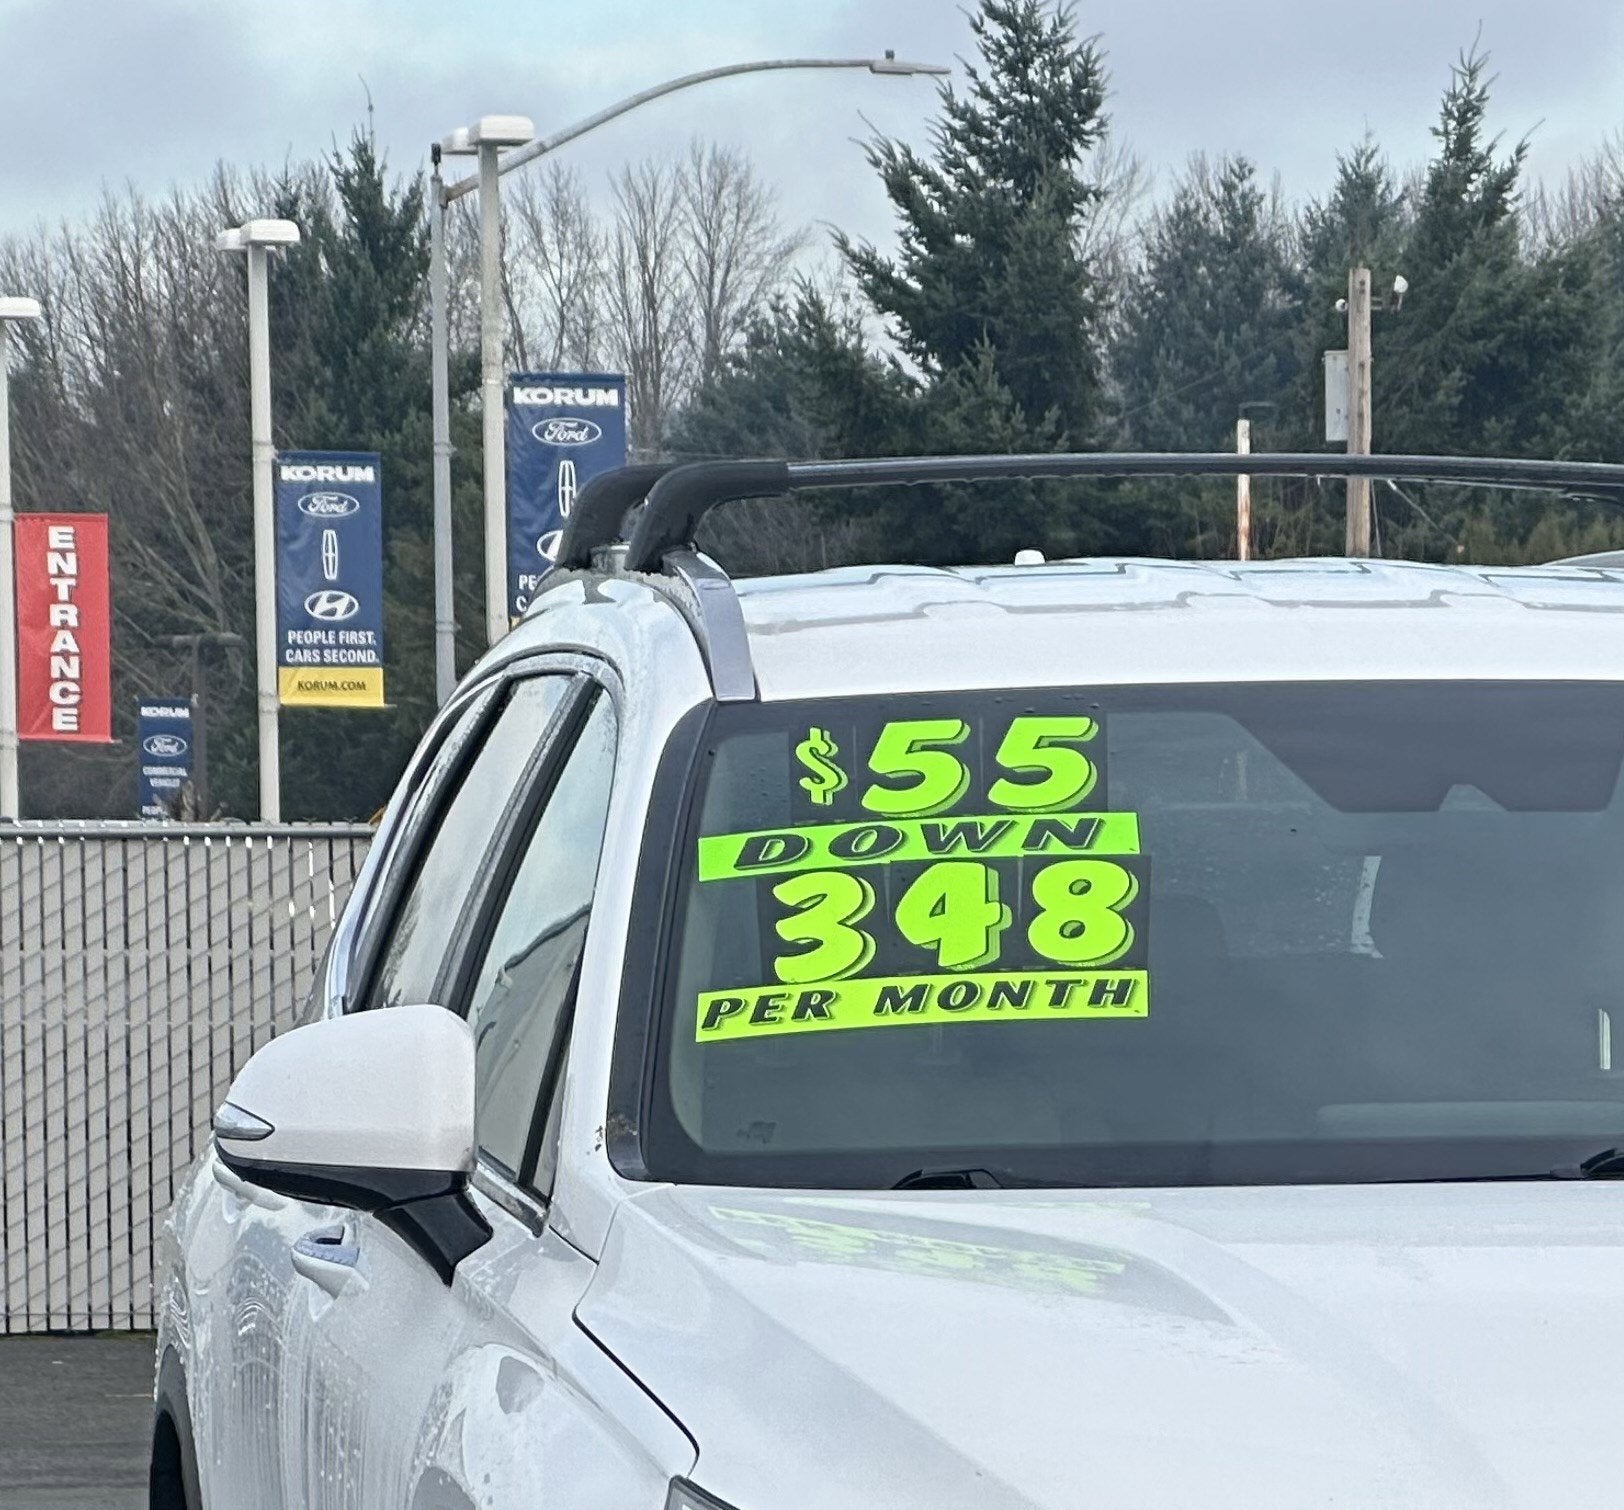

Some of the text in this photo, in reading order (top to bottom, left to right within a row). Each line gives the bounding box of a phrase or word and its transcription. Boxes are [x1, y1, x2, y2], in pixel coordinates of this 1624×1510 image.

[513, 386, 619, 407] KORUM
[544, 420, 588, 442] Ford
[280, 464, 375, 483] KORUM
[307, 495, 349, 513] Ford
[46, 525, 82, 732] ENTRANCE
[288, 629, 336, 645] PEOPLE
[285, 649, 321, 663] CARS
[297, 679, 367, 692] KORUM.COM
[795, 716, 1099, 816] $55
[733, 818, 1106, 871] DOWN
[772, 859, 1140, 983] 348
[701, 978, 1139, 1031] PER MONTH
